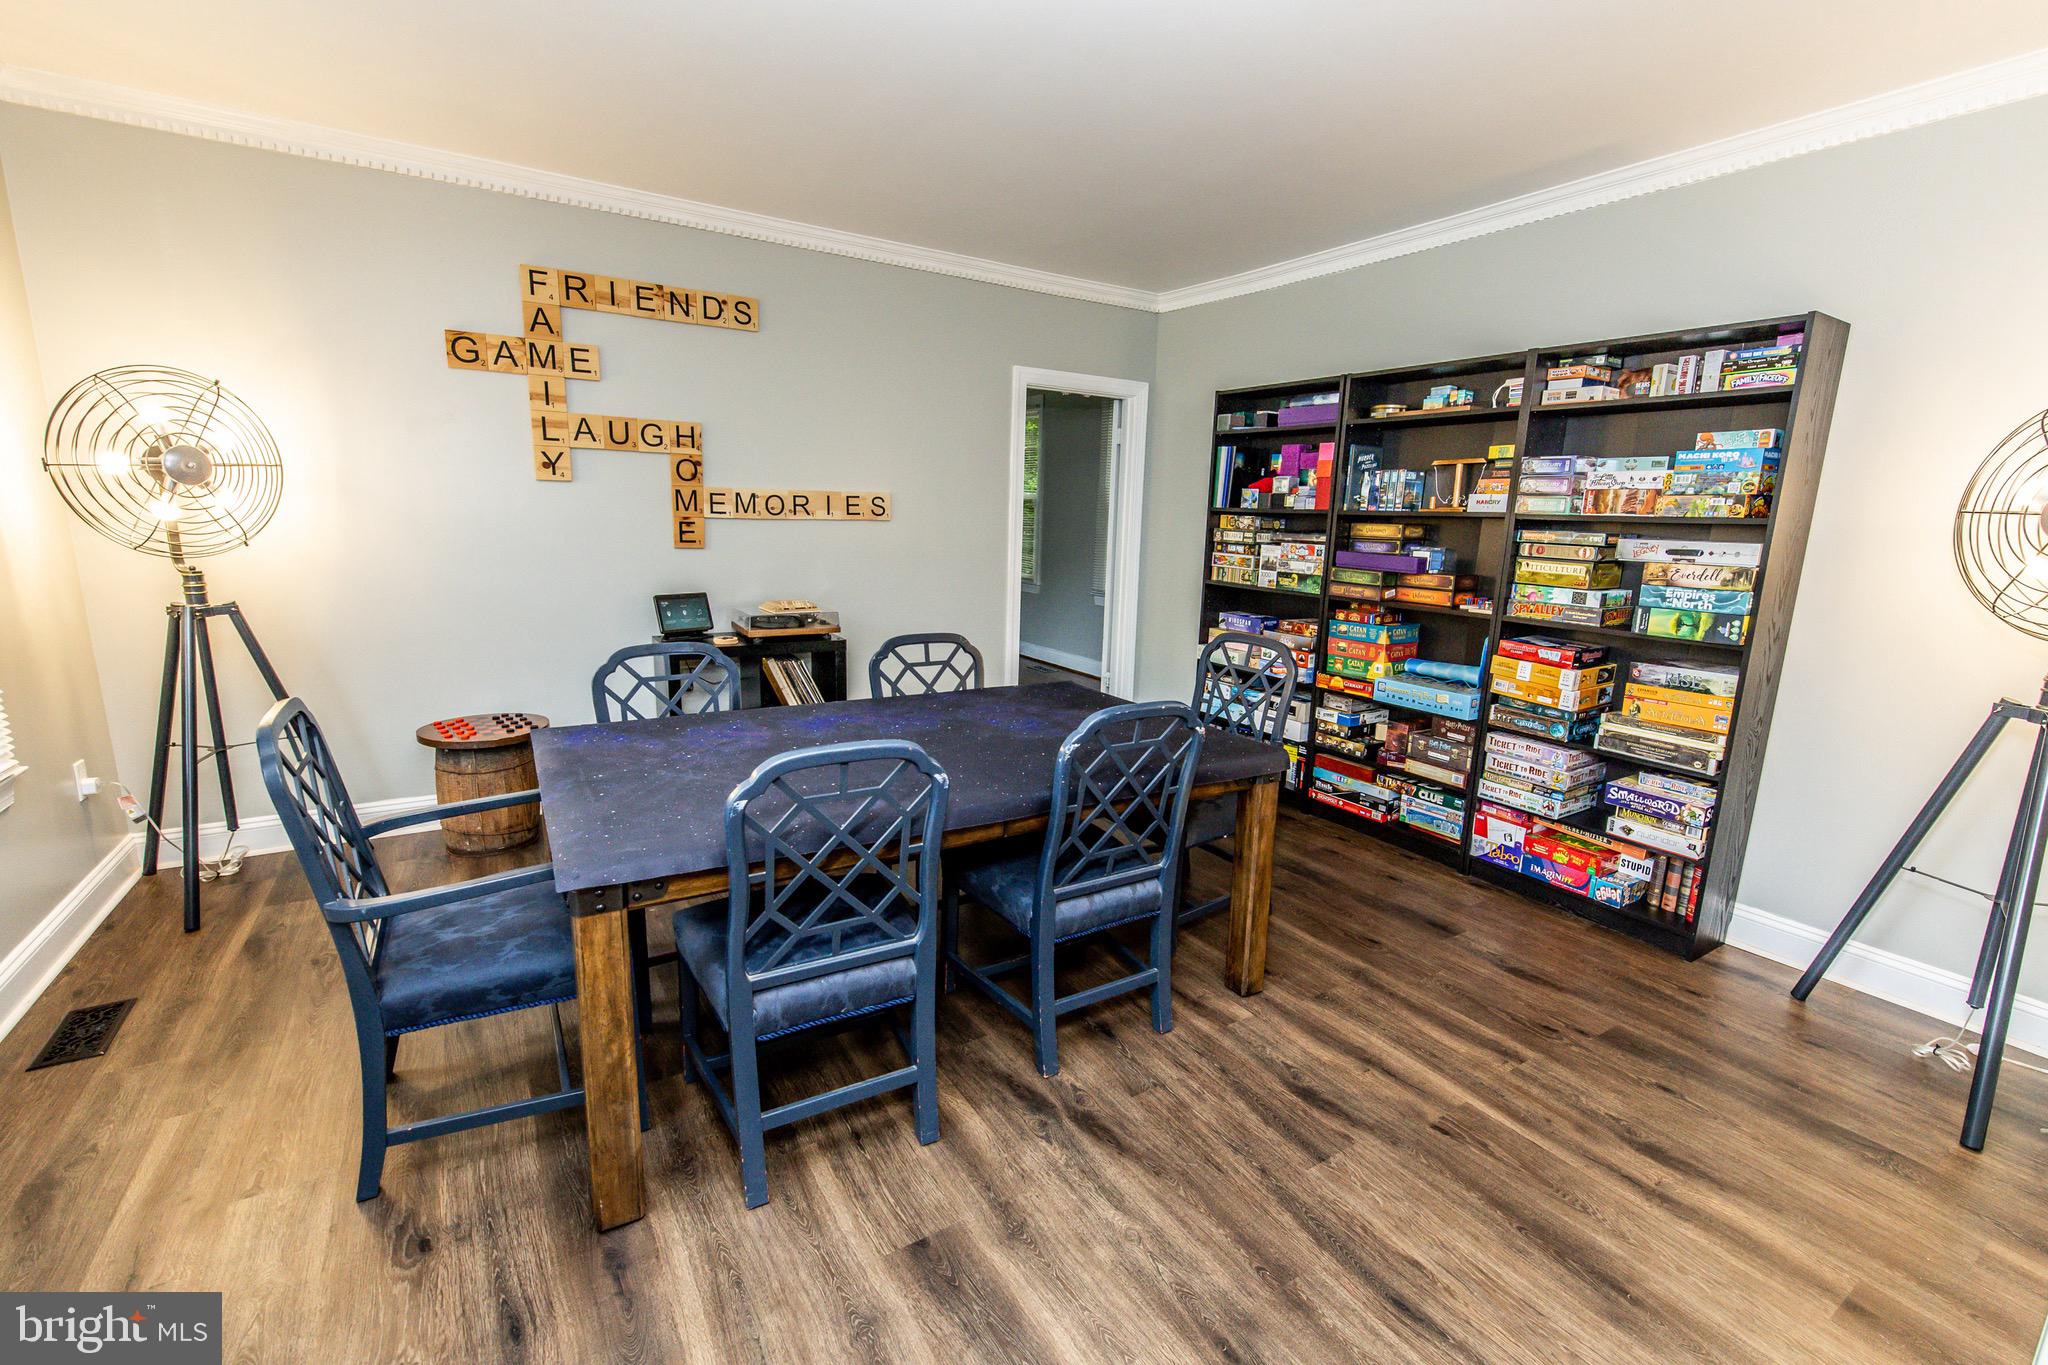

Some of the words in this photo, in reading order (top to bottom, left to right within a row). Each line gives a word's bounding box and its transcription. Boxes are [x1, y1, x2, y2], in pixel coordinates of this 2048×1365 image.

[528, 269, 752, 325] FRIENDS
[450, 335, 592, 374] GAME
[528, 269, 564, 476] FAMILY
[1730, 374, 1758, 388] FAMILY
[541, 415, 695, 449] LAUGH
[1712, 451, 1741, 460] KORO
[675, 425, 698, 543] HOME
[675, 488, 886, 517] MEMORIES
[1632, 544, 1660, 558] LEGACY
[1523, 562, 1586, 575] VITICULTURE
[1670, 568, 1724, 582] Everdell
[1665, 588, 1716, 602] Empires
[1512, 602, 1531, 616] SPY
[1532, 603, 1565, 616] ALLEY
[1671, 598, 1713, 610] North
[1349, 625, 1367, 634] CATAN
[1348, 647, 1366, 656] CATAN
[1347, 659, 1364, 667] CATAN
[1488, 736, 1518, 750] TICKET
[1525, 744, 1542, 754] RIDE
[1492, 756, 1520, 772] TICKET
[1528, 766, 1548, 780] RIDE
[1316, 780, 1333, 792] Risk
[1481, 782, 1502, 794] TICKET
[1508, 789, 1522, 799] RIDE
[1418, 790, 1444, 806] CLUE
[1622, 808, 1657, 824] MUNCHKIN
[1486, 841, 1520, 864] Taboo
[1620, 858, 1652, 876] STUPID
[1595, 886, 1622, 903] Jenga
